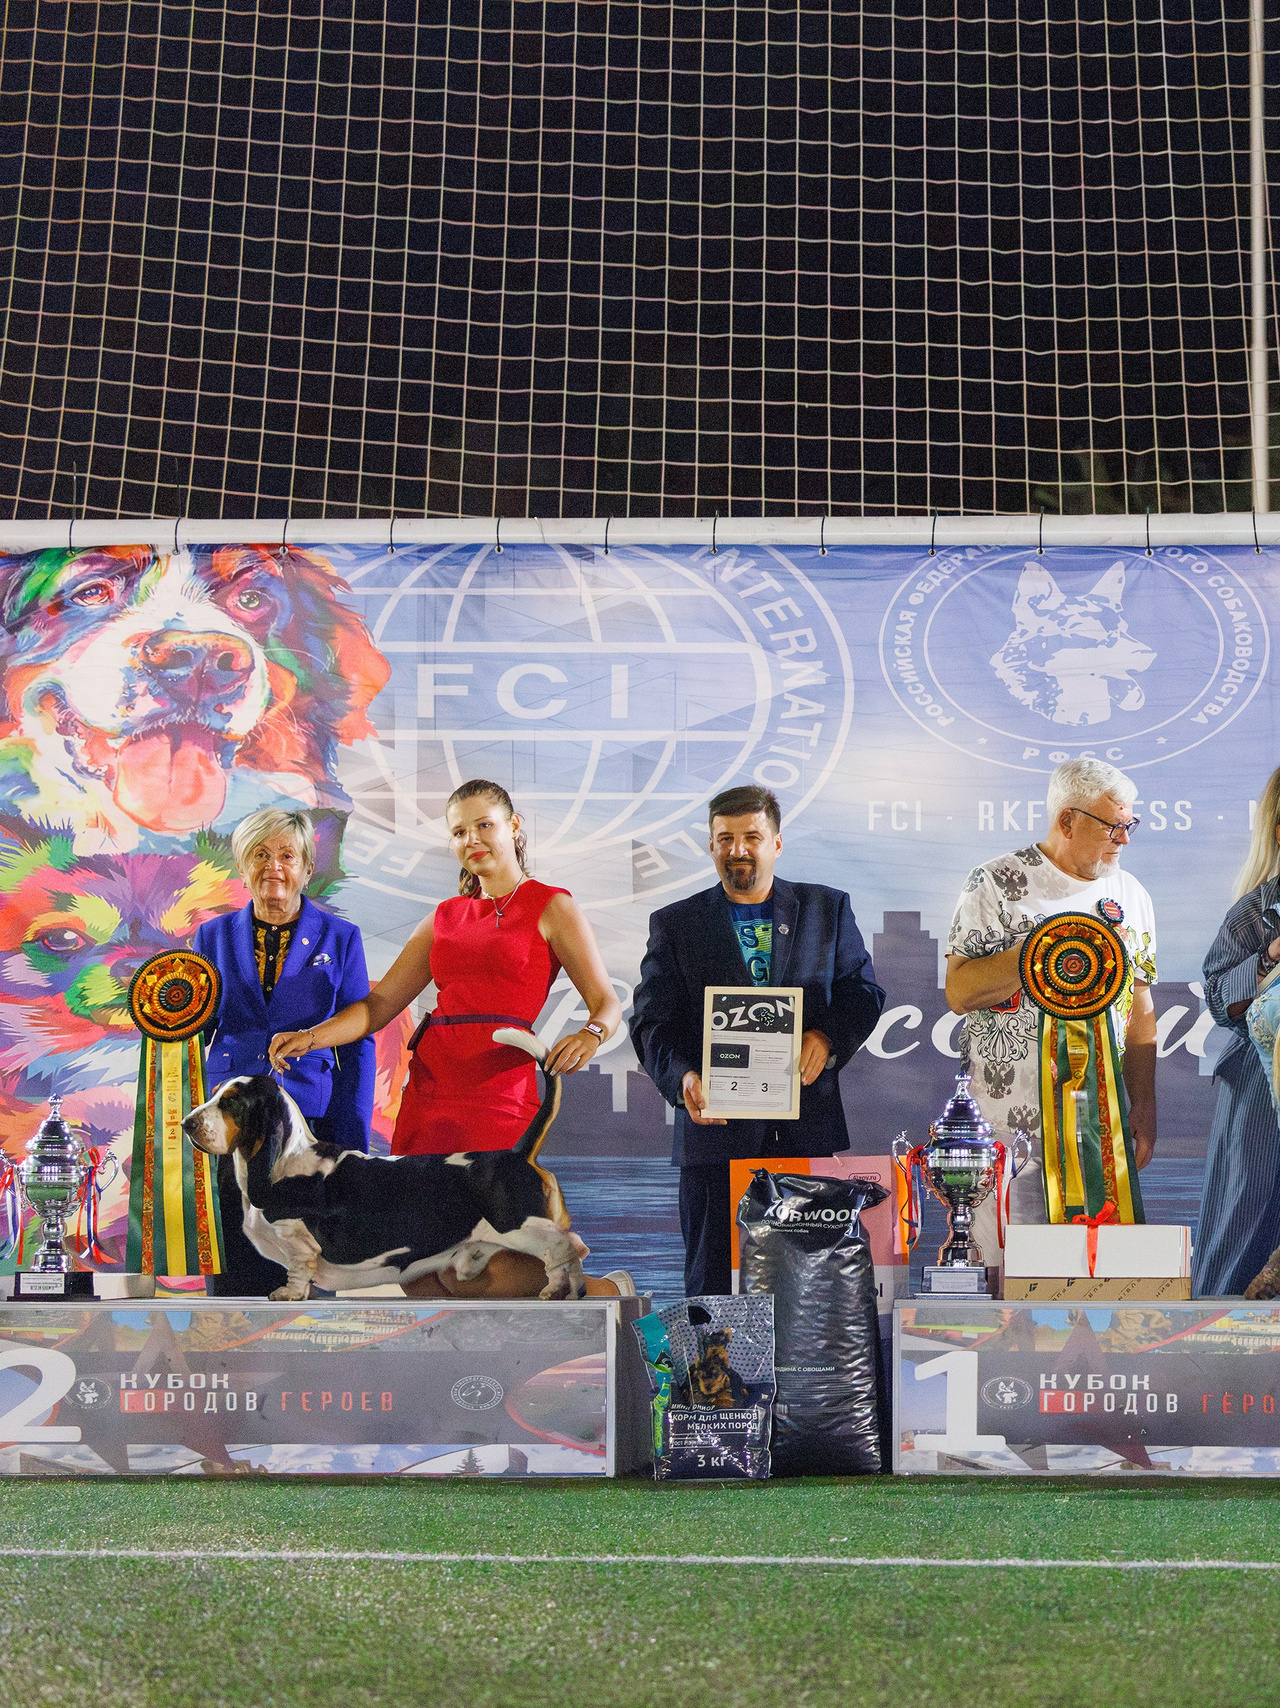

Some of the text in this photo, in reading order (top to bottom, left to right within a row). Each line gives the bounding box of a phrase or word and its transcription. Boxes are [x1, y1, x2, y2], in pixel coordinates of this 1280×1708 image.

[893, 610, 955, 727] РОССИЙСКАЯ
[1190, 575, 1253, 724] СОБАКОВОДСТВА
[416, 662, 630, 720] FCI
[868, 801, 922, 831] FCI
[979, 801, 1045, 831] RKF
[731, 1081, 769, 1092] 2 3
[120, 1373, 230, 1389] КУБОК
[1040, 1374, 1151, 1390] КУБОК
[0, 1346, 82, 1443] 2
[123, 1392, 394, 1412] ГОРОДОВ ГЕРОЕВ
[913, 1351, 1006, 1452] 1
[1043, 1392, 1178, 1414] ГОРОДОВ
[673, 1412, 758, 1422] КОРМ ДЛЯ ЩЕНКОВ
[687, 1422, 758, 1430] МЕЛКИХ ПОРОД
[698, 1454, 706, 1467] 3
